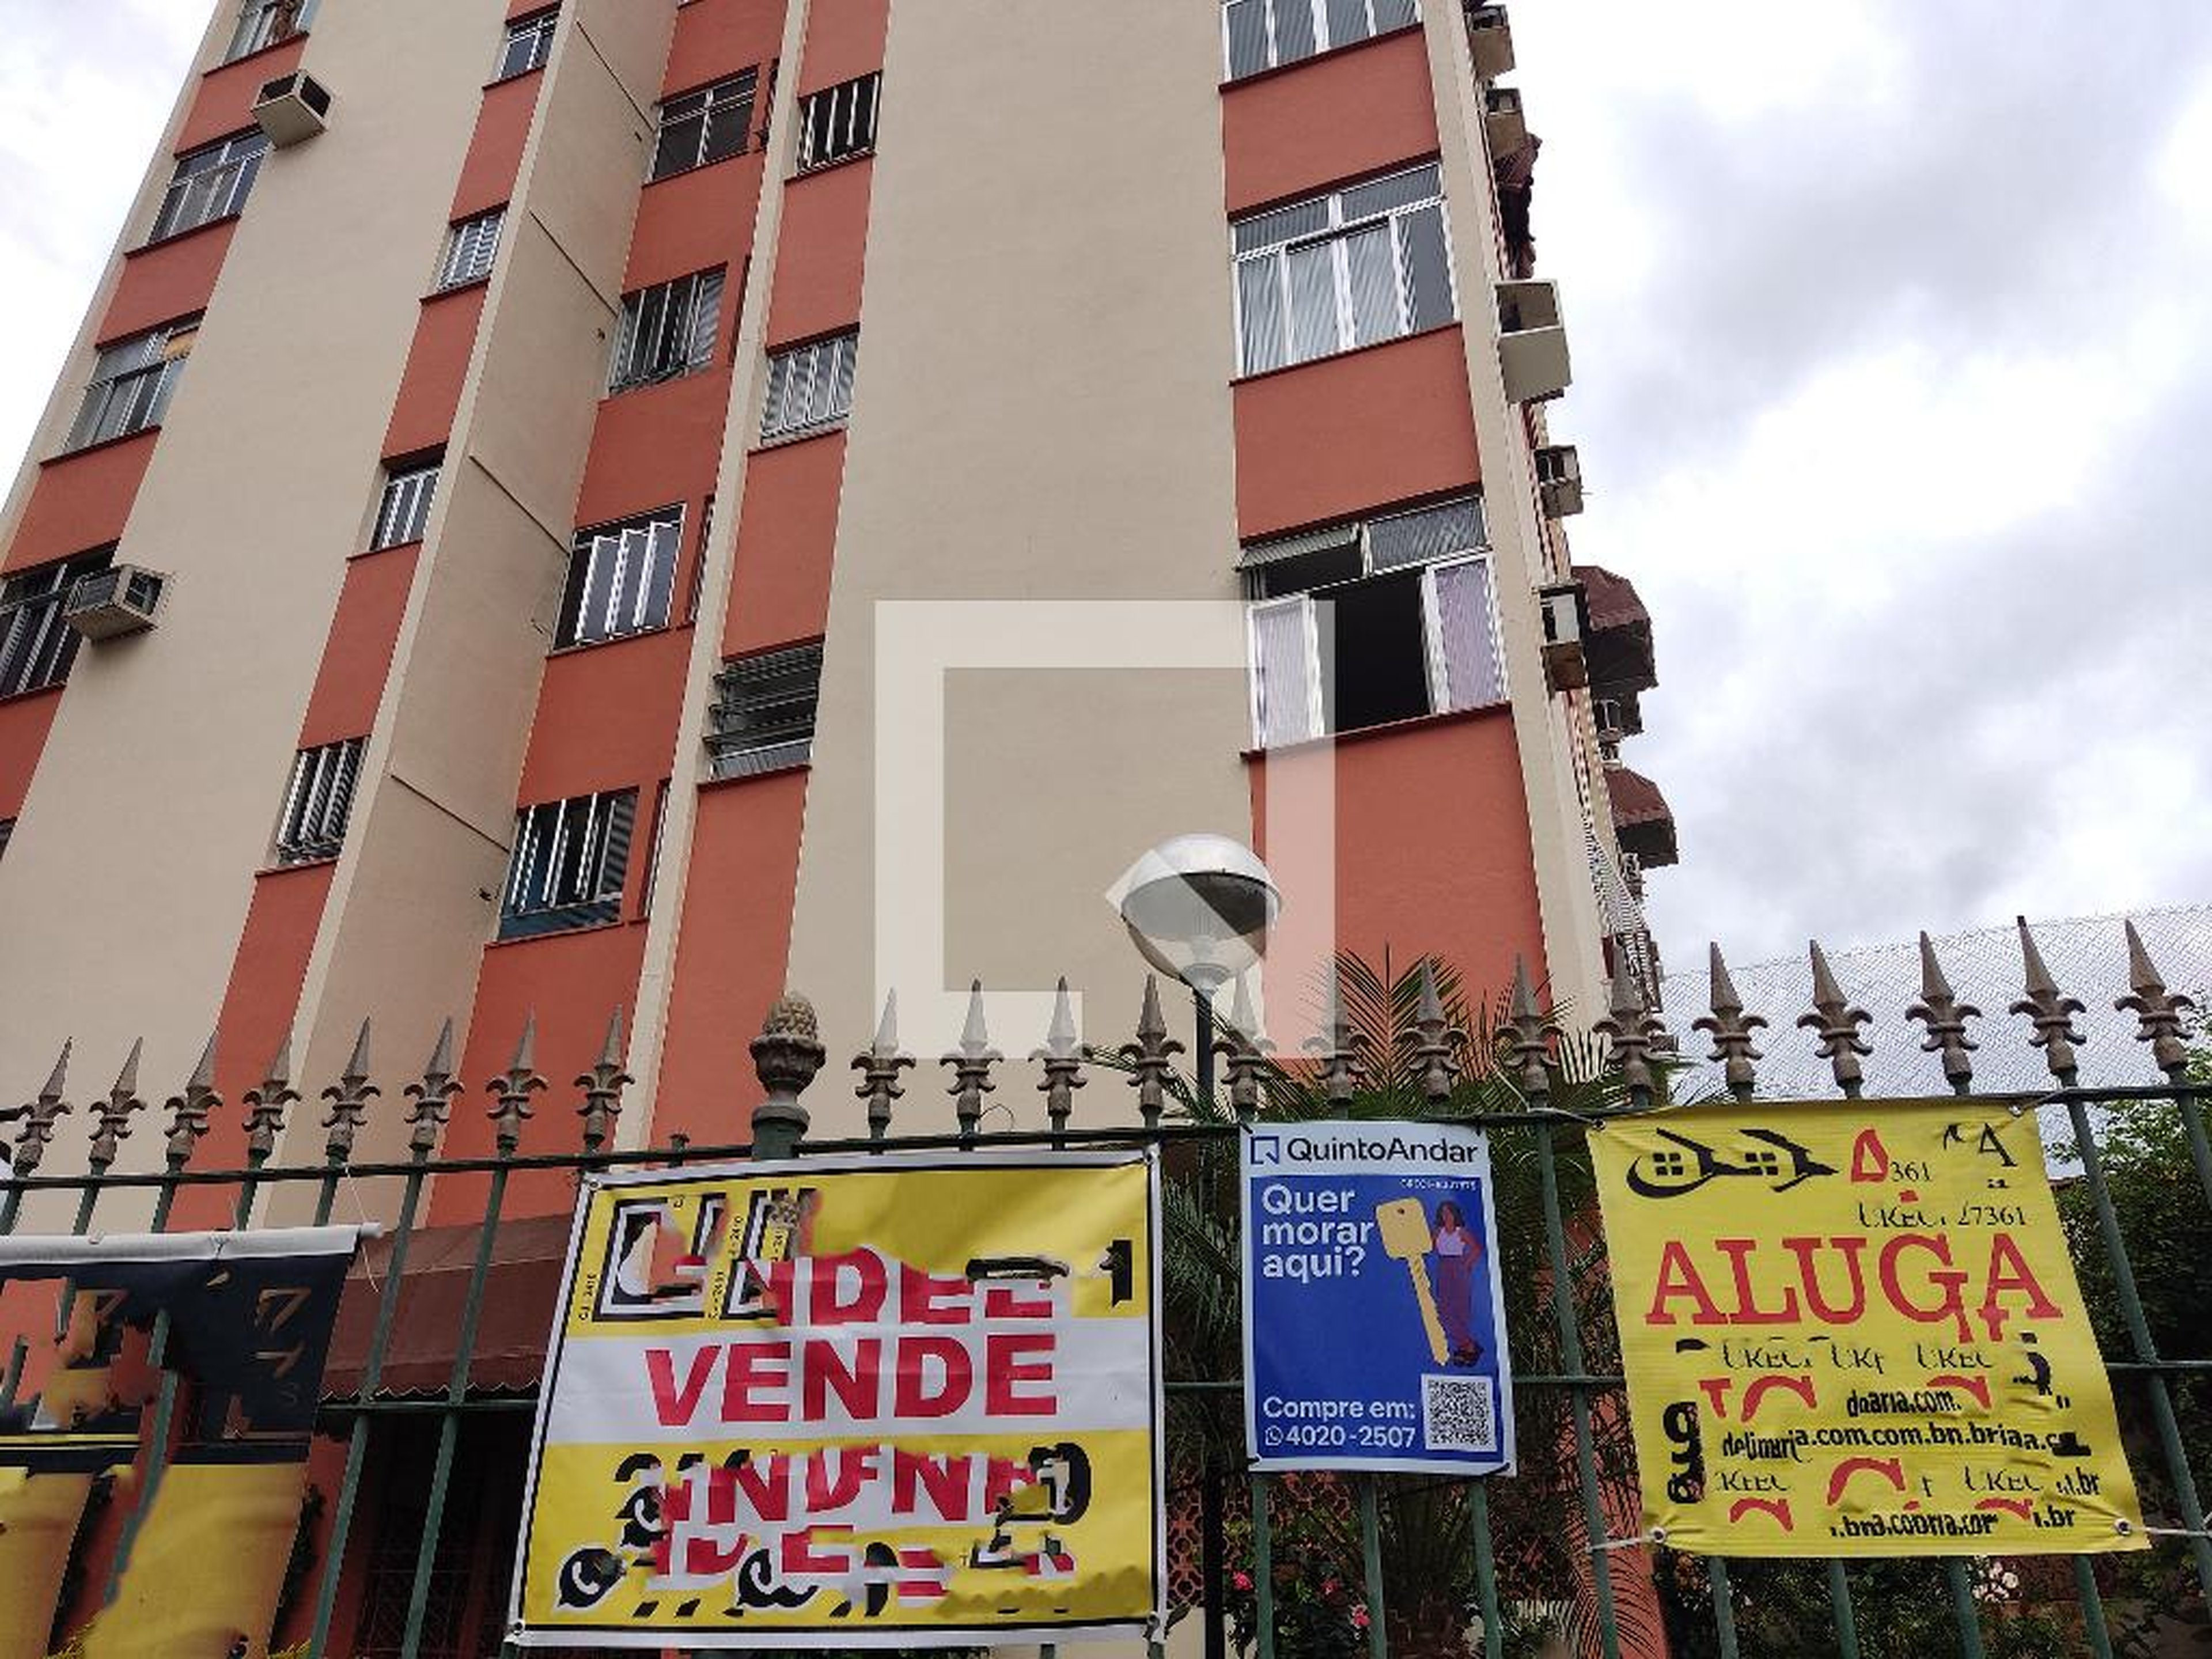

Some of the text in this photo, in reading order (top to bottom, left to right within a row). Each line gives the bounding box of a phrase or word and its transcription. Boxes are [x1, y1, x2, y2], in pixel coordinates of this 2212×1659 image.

[1287, 1137, 1479, 1163] QuintoAndar
[1262, 1183, 1355, 1215] Quer
[1262, 1221, 1375, 1245] morar
[1262, 1245, 1366, 1284] aqui?
[1645, 1233, 2063, 1327] ALUGA
[644, 1333, 1058, 1427] VENDE
[1263, 1396, 1416, 1423] Compre em:
